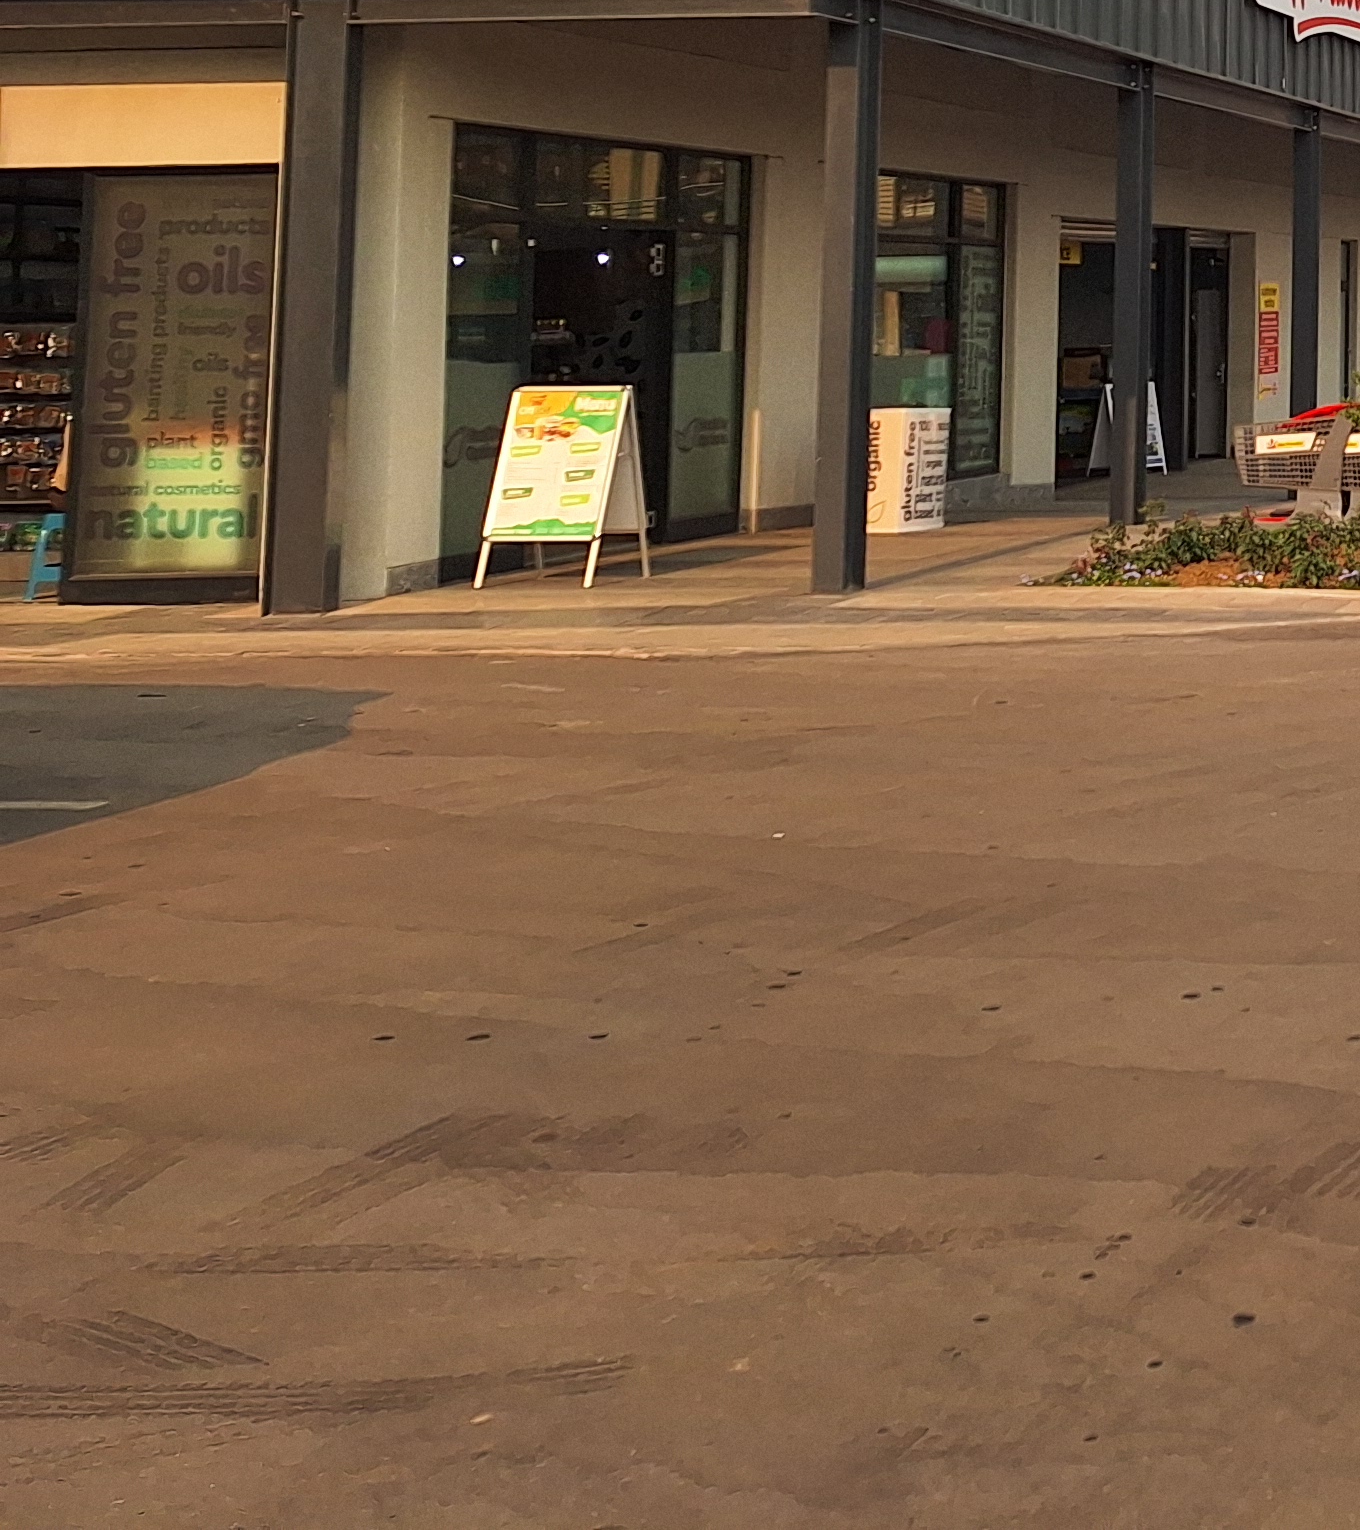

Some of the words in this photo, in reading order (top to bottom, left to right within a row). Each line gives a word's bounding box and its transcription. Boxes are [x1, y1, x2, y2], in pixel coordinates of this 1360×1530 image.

[99, 201, 147, 297] free
[177, 244, 266, 295] oils
[89, 311, 140, 468] gluten
[146, 431, 197, 449] plant
[206, 385, 229, 471] organic
[904, 421, 917, 457] free
[153, 479, 242, 496] cosmetics
[901, 462, 915, 522] gluten
[84, 492, 258, 541] natural
